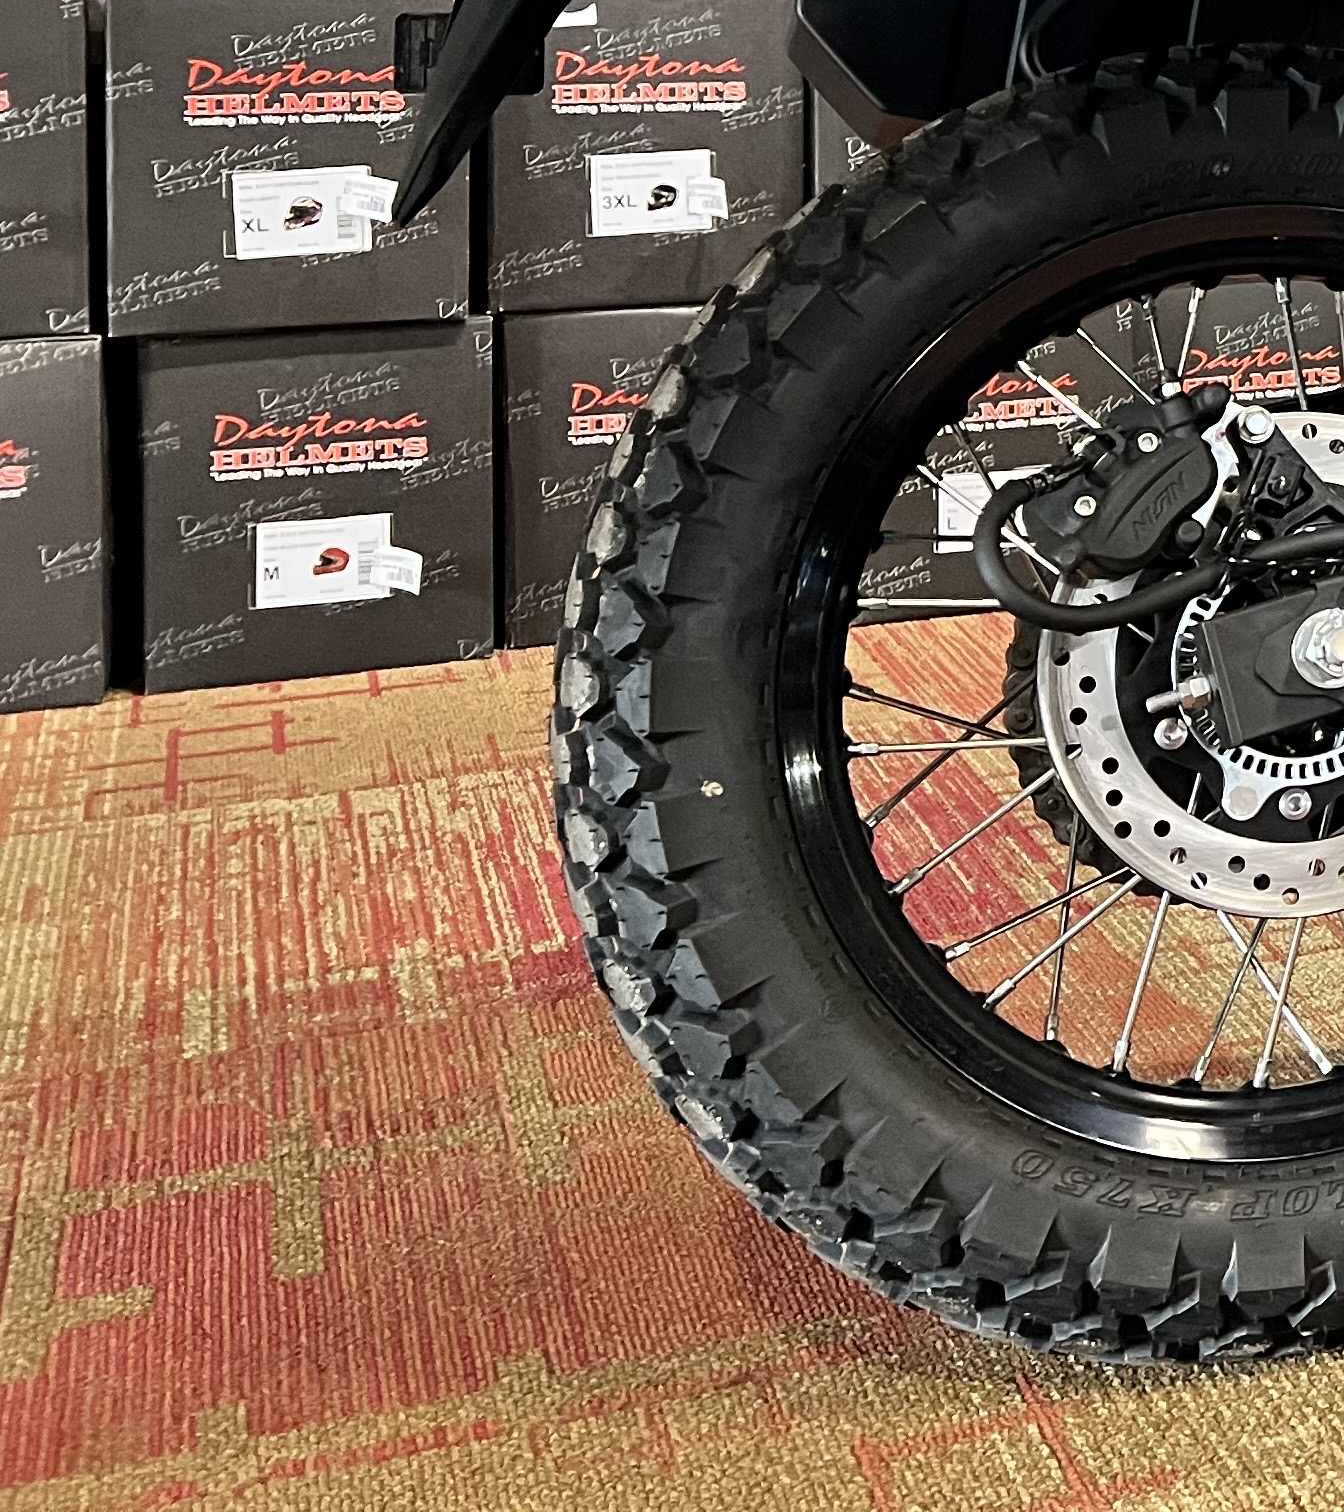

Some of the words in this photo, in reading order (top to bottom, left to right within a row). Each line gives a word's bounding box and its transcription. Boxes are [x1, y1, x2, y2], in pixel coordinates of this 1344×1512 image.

[187, 59, 395, 98] Daytona
[556, 50, 746, 88] Daytona
[183, 91, 406, 116] HELMETS
[551, 81, 747, 104] HELMETS
[602, 195, 638, 210] 3XL
[241, 219, 269, 233] XL
[213, 411, 428, 452] Daytona
[209, 437, 429, 472] HELMETS
[263, 566, 280, 581] M
[1010, 1148, 1199, 1218] K750
